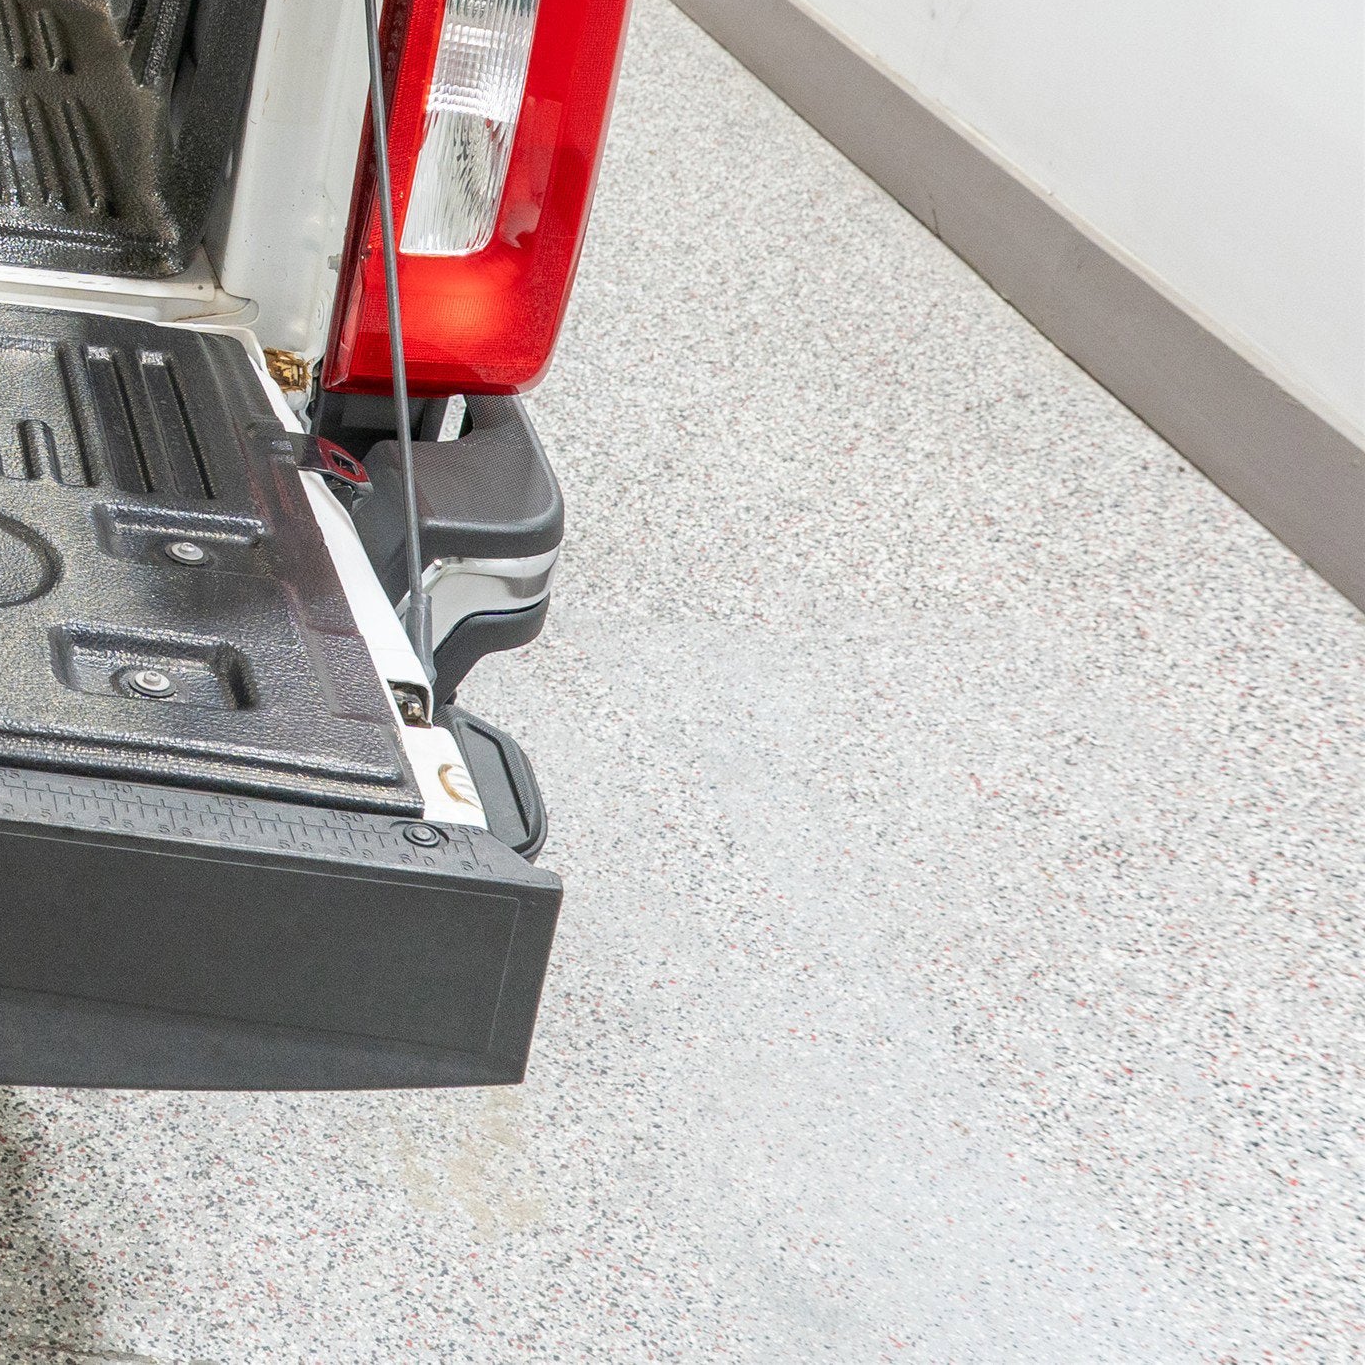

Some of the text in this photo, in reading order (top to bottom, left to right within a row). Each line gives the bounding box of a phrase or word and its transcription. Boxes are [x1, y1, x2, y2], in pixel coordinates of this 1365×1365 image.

[213, 795, 250, 810] 145
[327, 810, 365, 824] 150
[337, 845, 375, 860] 59
[398, 853, 437, 868] 60
